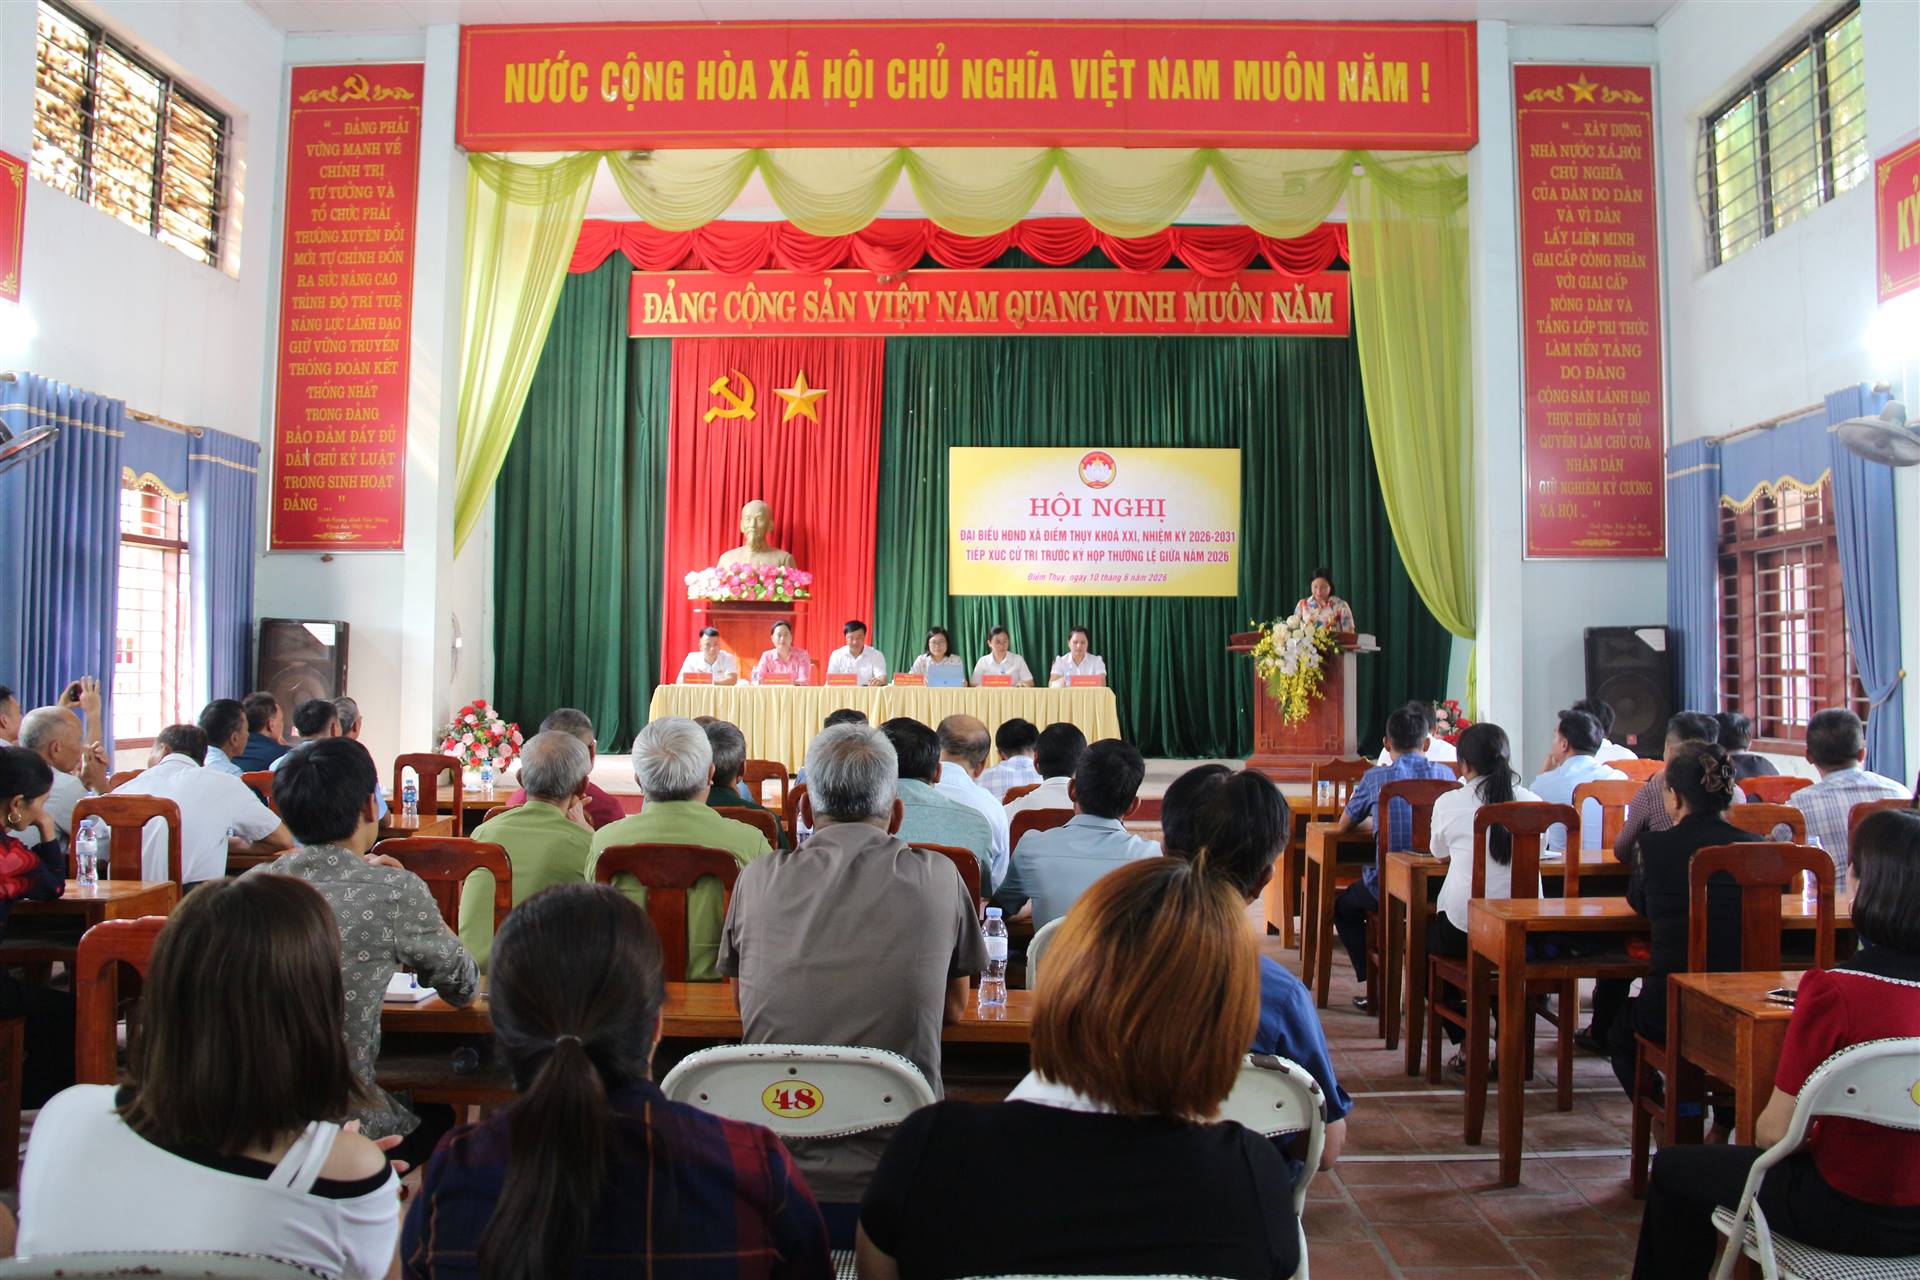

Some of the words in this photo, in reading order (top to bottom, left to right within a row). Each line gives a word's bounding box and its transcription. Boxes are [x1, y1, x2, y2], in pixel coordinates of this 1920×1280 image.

[505, 50, 589, 103] NƯỚC
[601, 52, 684, 110] CỘNG
[697, 51, 757, 101] HÒA
[768, 51, 810, 100] XÃ
[823, 49, 873, 107] HỘI
[887, 42, 948, 100] CHỦ
[962, 50, 1057, 100] NGHĨA
[1071, 50, 1136, 107] VIỆT
[1148, 58, 1219, 100] NAM
[1234, 51, 1326, 101] MUÔN
[1338, 53, 1408, 103] NĂM
[344, 116, 376, 135] ĐẢNG
[380, 116, 409, 134] PHẢI
[1584, 120, 1608, 136] XÂY
[1612, 124, 1642, 140] DỰNG
[344, 143, 380, 159] MẠNH
[1531, 140, 1557, 158] NHÀ
[320, 161, 360, 178] CHÍNH
[364, 164, 384, 180] TRỊ
[1551, 162, 1578, 179] CHỦ
[1583, 164, 1623, 180] NGHĨA
[378, 182, 395, 198] VÀ
[1532, 181, 1557, 200] CỦA
[1562, 184, 1588, 201] DÂN
[1592, 188, 1609, 201] DO
[1614, 186, 1642, 202] DÂN
[331, 204, 360, 220] CHỨC
[363, 202, 391, 219] PHẢI
[1556, 205, 1574, 222] VÀ
[1578, 206, 1590, 222] VÌ
[1595, 206, 1621, 223] DÂN
[341, 226, 380, 242] XUYÊN
[1544, 224, 1568, 244] LẤY
[1572, 228, 1599, 246] LIÊN
[1603, 232, 1634, 246] MINH
[1533, 252, 1554, 266] GIAI
[1556, 248, 1577, 266] CẤP
[1580, 250, 1611, 266] CÔNG
[1614, 251, 1646, 268] NHÂN
[298, 273, 314, 287] RA
[375, 273, 398, 285] CAO
[1579, 275, 1602, 289] GIAI
[1606, 272, 1628, 289] CẤP
[330, 292, 348, 312] ĐỘ
[352, 291, 372, 308] TRÍ
[376, 291, 402, 310] TUỆ
[643, 279, 716, 324] ĐẢNG
[725, 282, 796, 330] CỘNG
[803, 279, 859, 322] SẢN
[864, 283, 929, 330] VIỆT
[938, 290, 998, 321] NAM
[1005, 290, 1097, 328] QUANG
[1104, 290, 1176, 322] VINH
[1184, 283, 1263, 324] MUÔN
[1272, 285, 1332, 324] NĂM
[1551, 294, 1582, 312] NÔNG
[1588, 295, 1612, 312] DÂN
[1616, 296, 1632, 312] VÀ
[1545, 338, 1571, 357] LÀM
[1603, 337, 1642, 358] TẢNG
[336, 358, 370, 375] ĐOÀN
[374, 357, 399, 374] KẾT
[1560, 366, 1581, 379] DO
[1585, 360, 1626, 379] ĐẢNG
[348, 380, 379, 398] NHẤT
[1571, 384, 1594, 403] SẢN
[305, 408, 343, 421] TRONG
[346, 400, 379, 420] ĐẢNG
[286, 425, 312, 443] BẢO
[316, 425, 345, 443] ĐẢM
[380, 424, 396, 442] ĐỦ
[1606, 430, 1627, 448] CHỦ
[1630, 431, 1651, 449] CỦA
[314, 448, 336, 465] CHỦ
[361, 449, 396, 468] LUẬT
[284, 476, 325, 488] TRONG
[328, 476, 357, 488] SINH
[360, 475, 394, 491] HOẠT
[284, 492, 317, 511] ĐẢNG
[1029, 492, 1081, 521] HỘI
[1092, 498, 1166, 523] NGHỊ
[1558, 501, 1578, 521] HỘI
[960, 530, 975, 543] ĐẠI
[978, 528, 998, 541] BIỂU
[1002, 530, 1026, 541] HĐND
[1030, 528, 1041, 541] XÃ
[1070, 530, 1092, 544] THỤY
[1122, 531, 1139, 542] XXI,
[1143, 528, 1172, 544] NHIỆM
[1190, 531, 1235, 542] 2026-2031
[1025, 550, 1037, 560] TRI
[1208, 551, 1229, 562] 2026
[772, 1088, 816, 1109] 48
